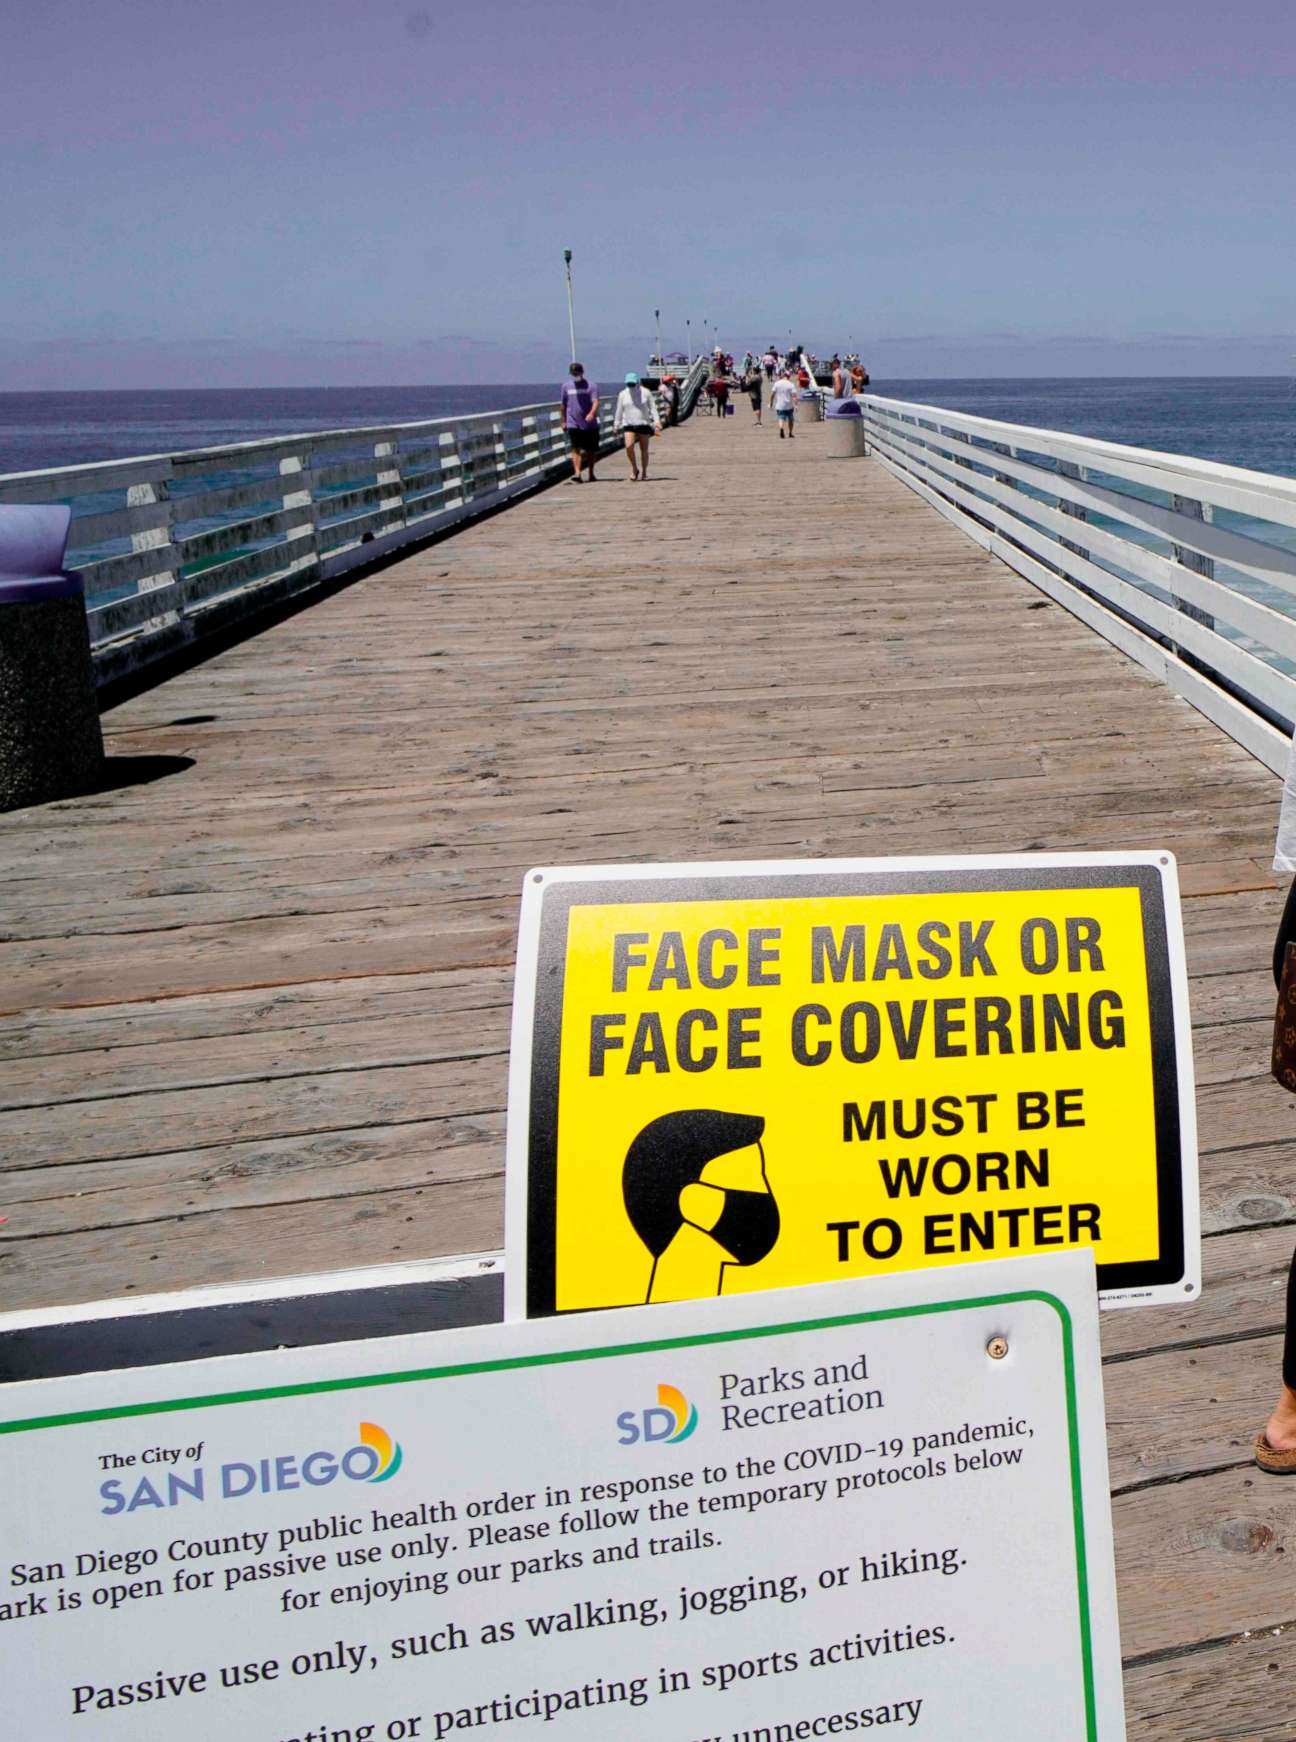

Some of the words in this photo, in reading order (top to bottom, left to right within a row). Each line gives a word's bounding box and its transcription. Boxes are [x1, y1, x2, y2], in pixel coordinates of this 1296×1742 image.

[611, 927, 781, 993] FACE
[811, 920, 997, 983] MASK
[1020, 917, 1105, 974] OR
[588, 1007, 762, 1077] FACE
[791, 990, 1126, 1067] COVERING
[843, 1094, 997, 1142] MUST
[1017, 1089, 1086, 1130] BE
[878, 1149, 1049, 1198] WORN
[827, 1217, 902, 1262] TO
[924, 1203, 1102, 1255] ENTER
[719, 1366, 805, 1400] Parks
[813, 1353, 869, 1386] and
[617, 1407, 676, 1445] SD
[720, 1387, 884, 1431] Recreation
[97, 1453, 136, 1470] The
[140, 1446, 181, 1464] City
[185, 1440, 205, 1461] of
[100, 1467, 204, 1515] SAN
[221, 1445, 379, 1498] DIEGO
[10, 1562, 65, 1586] San
[74, 1548, 158, 1576] Diego
[167, 1531, 269, 1561] County
[277, 1514, 362, 1552] public
[370, 1499, 457, 1532] health
[465, 1491, 536, 1518] order
[544, 1485, 571, 1507] in
[579, 1471, 693, 1502] response
[701, 1466, 727, 1484] to
[735, 1456, 775, 1479] the
[783, 1438, 903, 1471] COVID-19
[911, 1416, 1034, 1457] pandemic,
[0, 1592, 48, 1621] ark
[56, 1587, 82, 1611] is
[91, 1579, 164, 1609] open
[172, 1568, 214, 1592] for
[223, 1552, 326, 1591] passive
[335, 1546, 381, 1567] use
[390, 1532, 457, 1559] only.
[467, 1521, 550, 1548] Please
[558, 1508, 639, 1534] follow
[647, 1498, 688, 1521] the
[697, 1479, 827, 1514] temporary
[835, 1456, 946, 1498] protocols
[952, 1447, 1023, 1473] below
[279, 1588, 320, 1612] for
[329, 1571, 448, 1606] enjoying
[456, 1563, 501, 1584] our
[509, 1548, 583, 1583] parks
[592, 1536, 640, 1564] and
[647, 1527, 722, 1556] trails.
[71, 1670, 206, 1714] Passive
[218, 1659, 279, 1687] use
[291, 1640, 377, 1675] only,
[390, 1622, 469, 1659] such
[480, 1621, 515, 1644] as
[524, 1597, 667, 1636] walking,
[679, 1575, 806, 1620] jogging,
[818, 1566, 850, 1589] or
[858, 1547, 967, 1582] hiking.
[280, 1725, 375, 1742] ting
[386, 1715, 422, 1740] or
[433, 1677, 648, 1740] participating
[658, 1667, 691, 1694] in
[701, 1651, 798, 1691] sports
[808, 1624, 955, 1667] activities.
[731, 1698, 924, 1742] unnecessary
